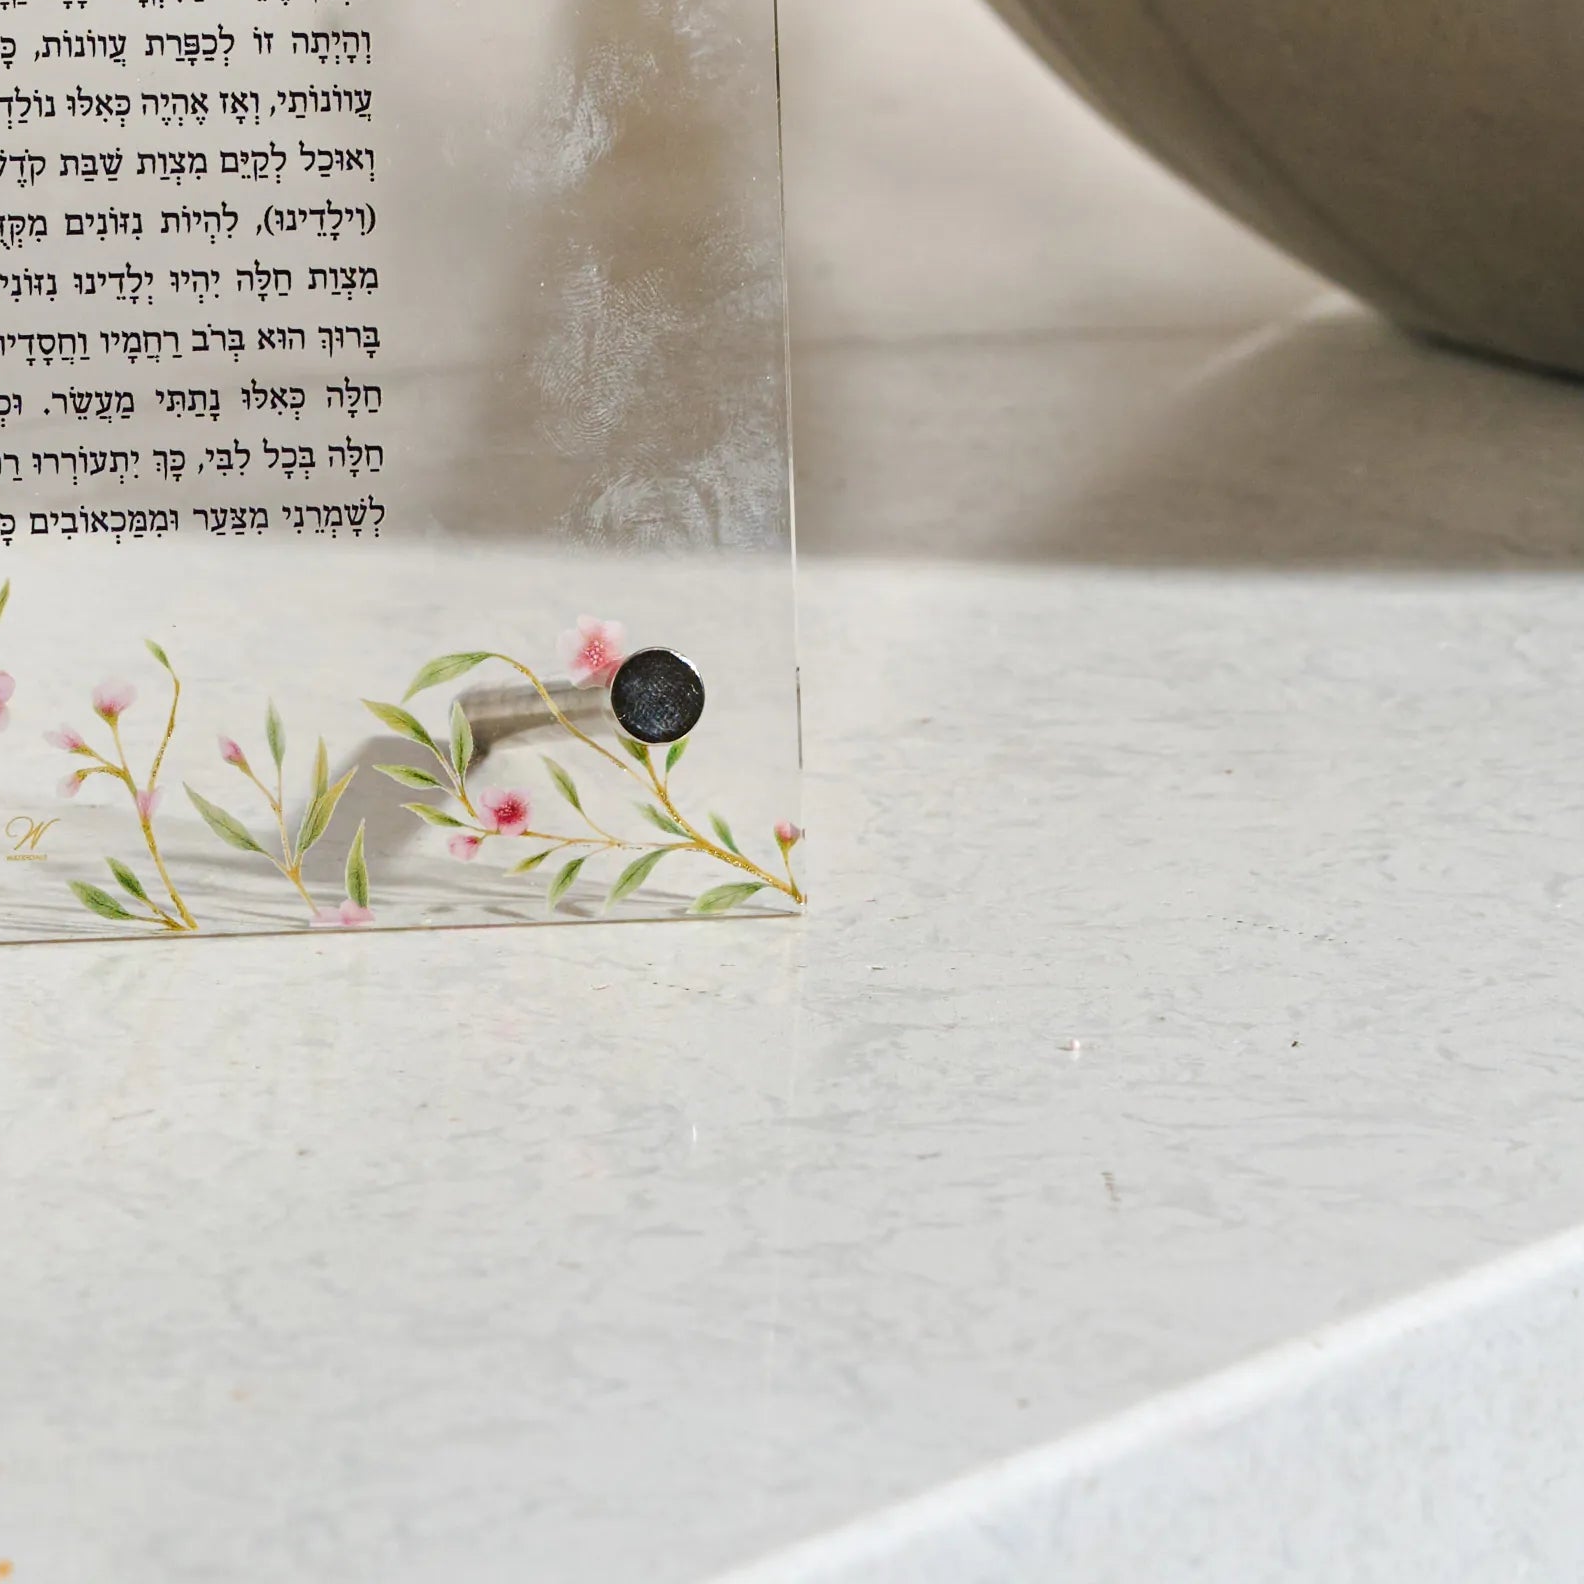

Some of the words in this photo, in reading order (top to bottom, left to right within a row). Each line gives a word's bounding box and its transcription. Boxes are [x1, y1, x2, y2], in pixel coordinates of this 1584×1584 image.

[252, 26, 274, 55] זוֹ
[218, 90, 260, 126] וְאָז
[257, 326, 306, 350] הוּא
